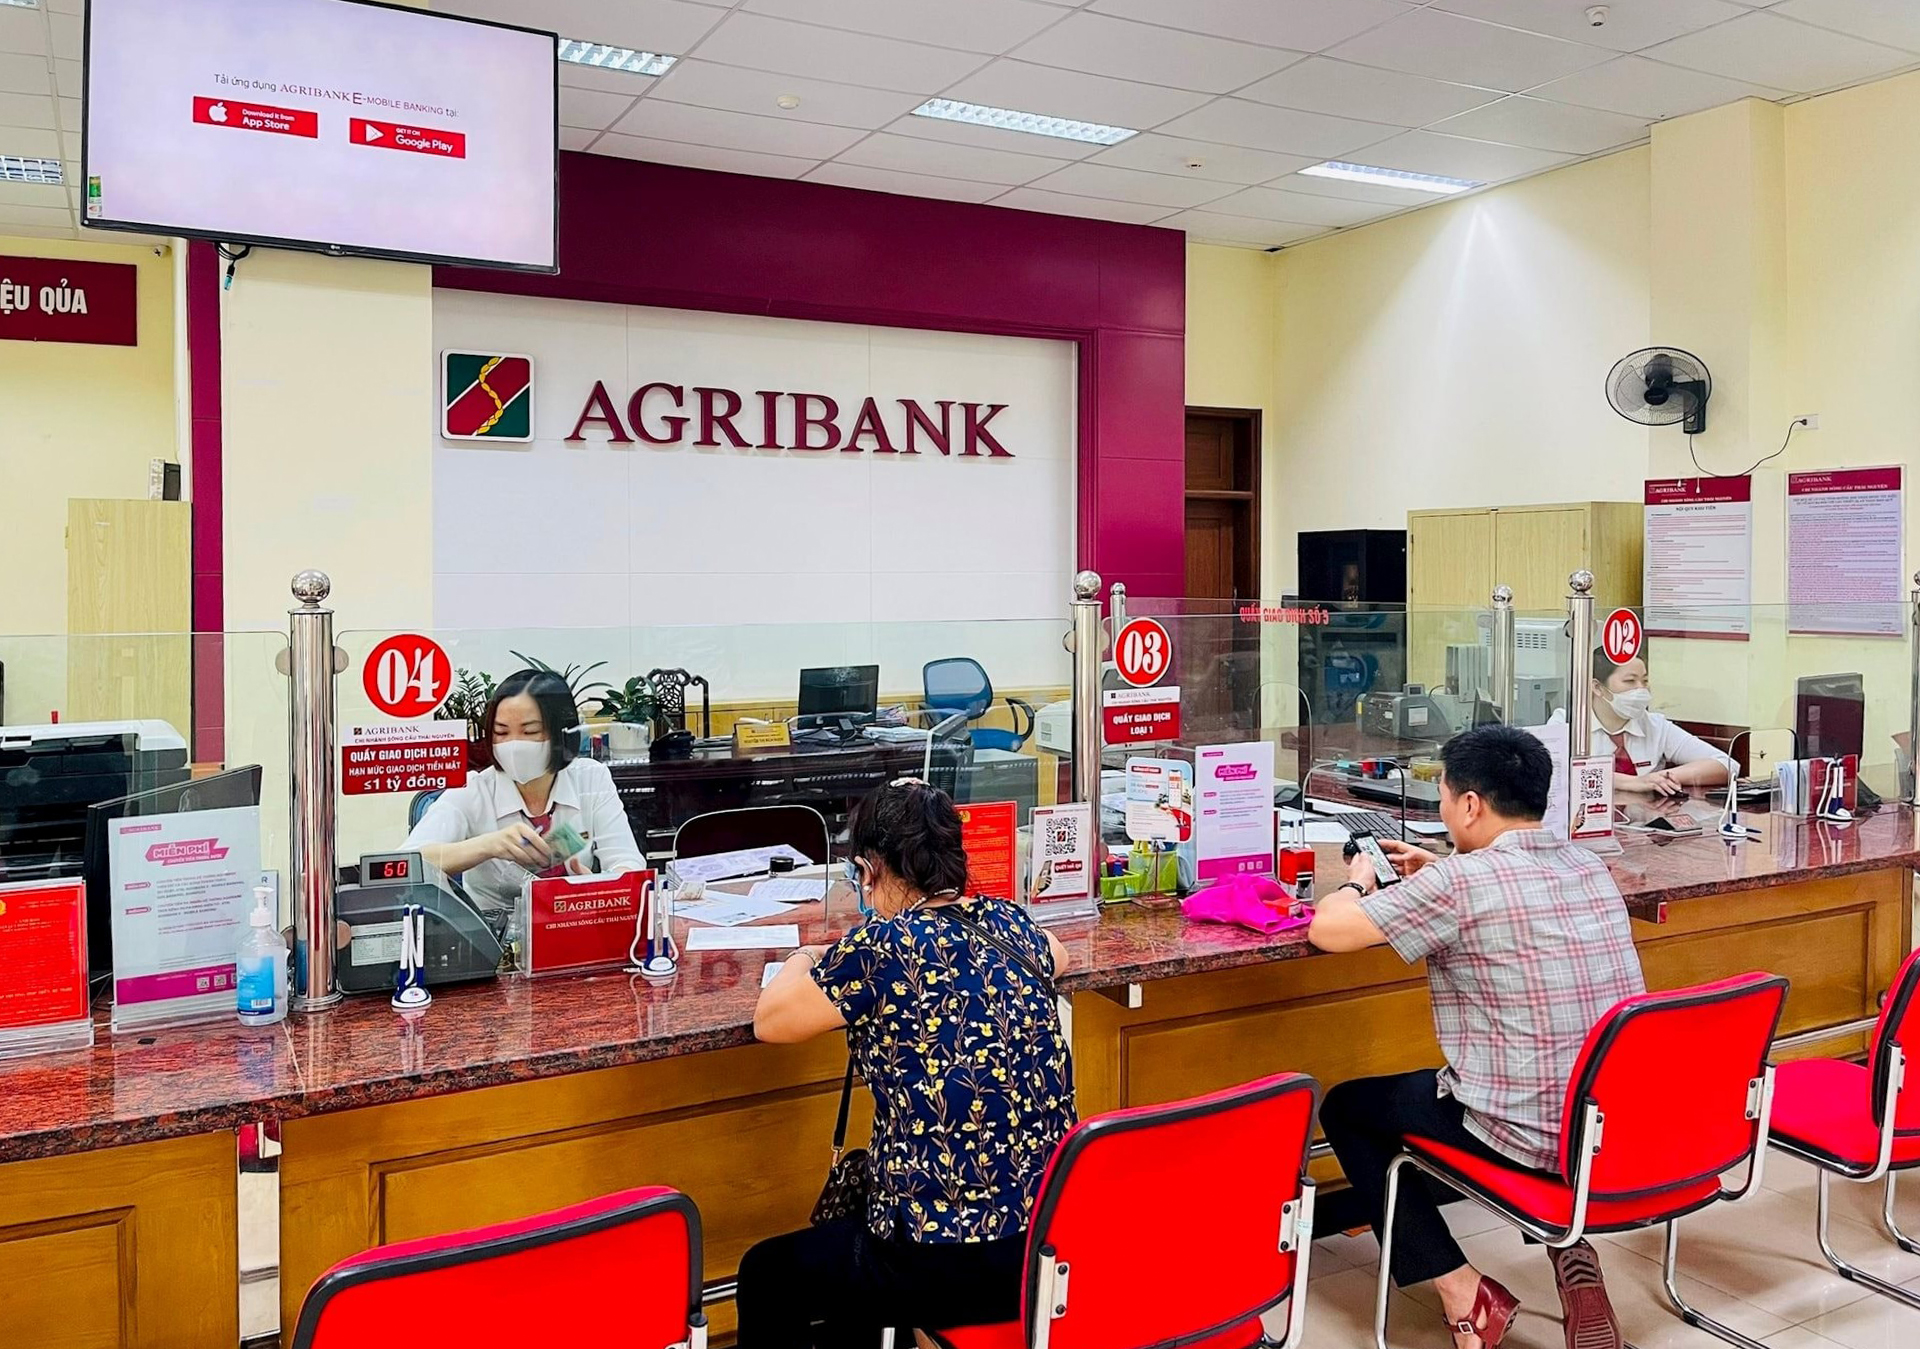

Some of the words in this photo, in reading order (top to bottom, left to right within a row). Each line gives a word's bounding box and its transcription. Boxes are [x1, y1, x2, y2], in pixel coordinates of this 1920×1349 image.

[252, 80, 277, 92] dụng
[280, 83, 350, 102] AGRIBANK
[403, 101, 443, 115] BANKING
[242, 116, 263, 128] App
[264, 119, 290, 130] Store
[395, 135, 430, 149] Google
[432, 140, 453, 153] Play
[39, 278, 88, 315] QỦA
[564, 379, 1016, 458] AGRIBANK
[1609, 619, 1635, 656] 02
[1123, 630, 1163, 675] 03
[376, 647, 441, 705] 04
[1134, 713, 1152, 723] GIAO
[1153, 712, 1171, 722] DỊCH
[364, 726, 420, 735] AGRIBANK
[1130, 726, 1147, 736] LOẠI
[1148, 725, 1153, 733] 1
[379, 750, 402, 760] GIAO
[404, 748, 427, 761] DỊCH
[429, 747, 451, 759] LOẠI
[453, 746, 459, 756] 2
[348, 767, 366, 778] HẠN
[386, 765, 405, 774] GIAO
[406, 764, 425, 774] DỊCH
[386, 775, 402, 791] tỷ
[406, 773, 446, 789] đồng
[384, 861, 407, 877] 60
[567, 896, 631, 912] AGRIBANK
